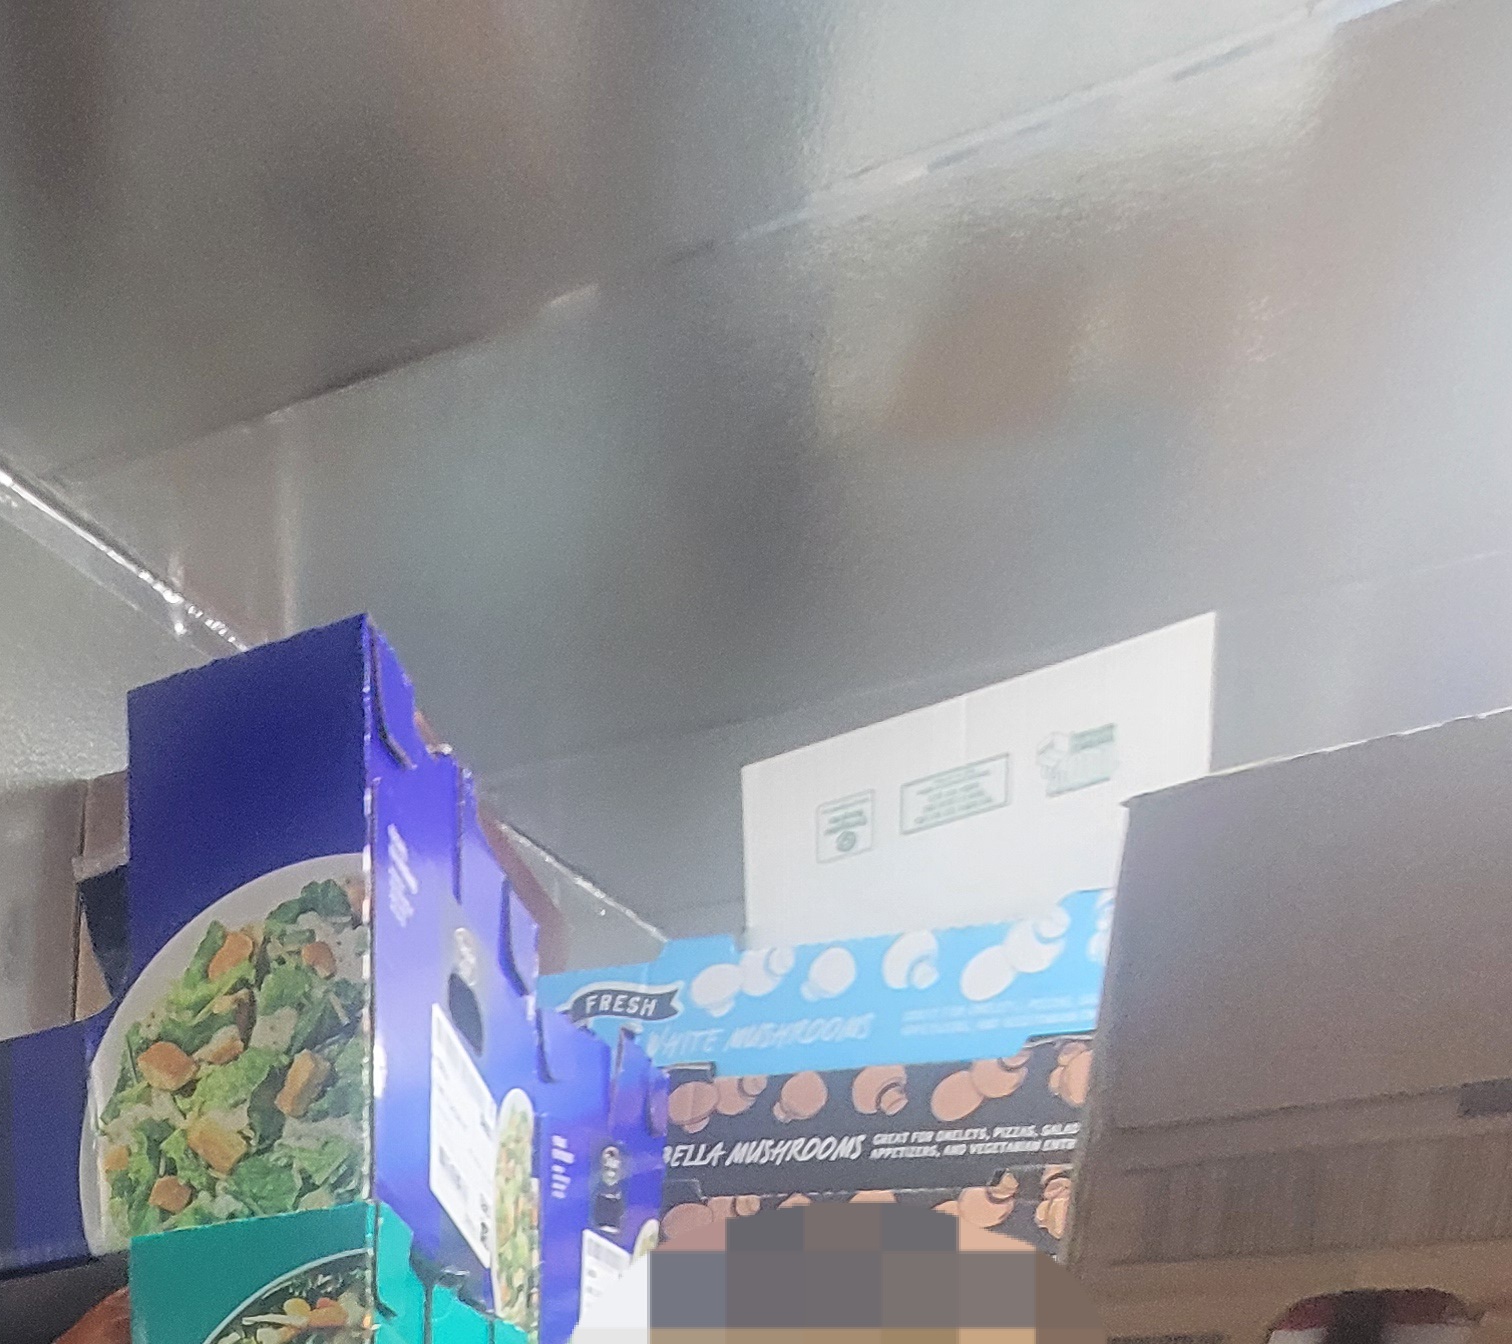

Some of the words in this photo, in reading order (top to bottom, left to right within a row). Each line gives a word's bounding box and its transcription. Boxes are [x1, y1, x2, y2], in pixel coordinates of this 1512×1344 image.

[586, 993, 658, 1018] FRESH
[646, 1025, 724, 1058] WHITE
[726, 1012, 875, 1050] MUSHROOMS
[726, 1133, 868, 1166] MUSHROOMS
